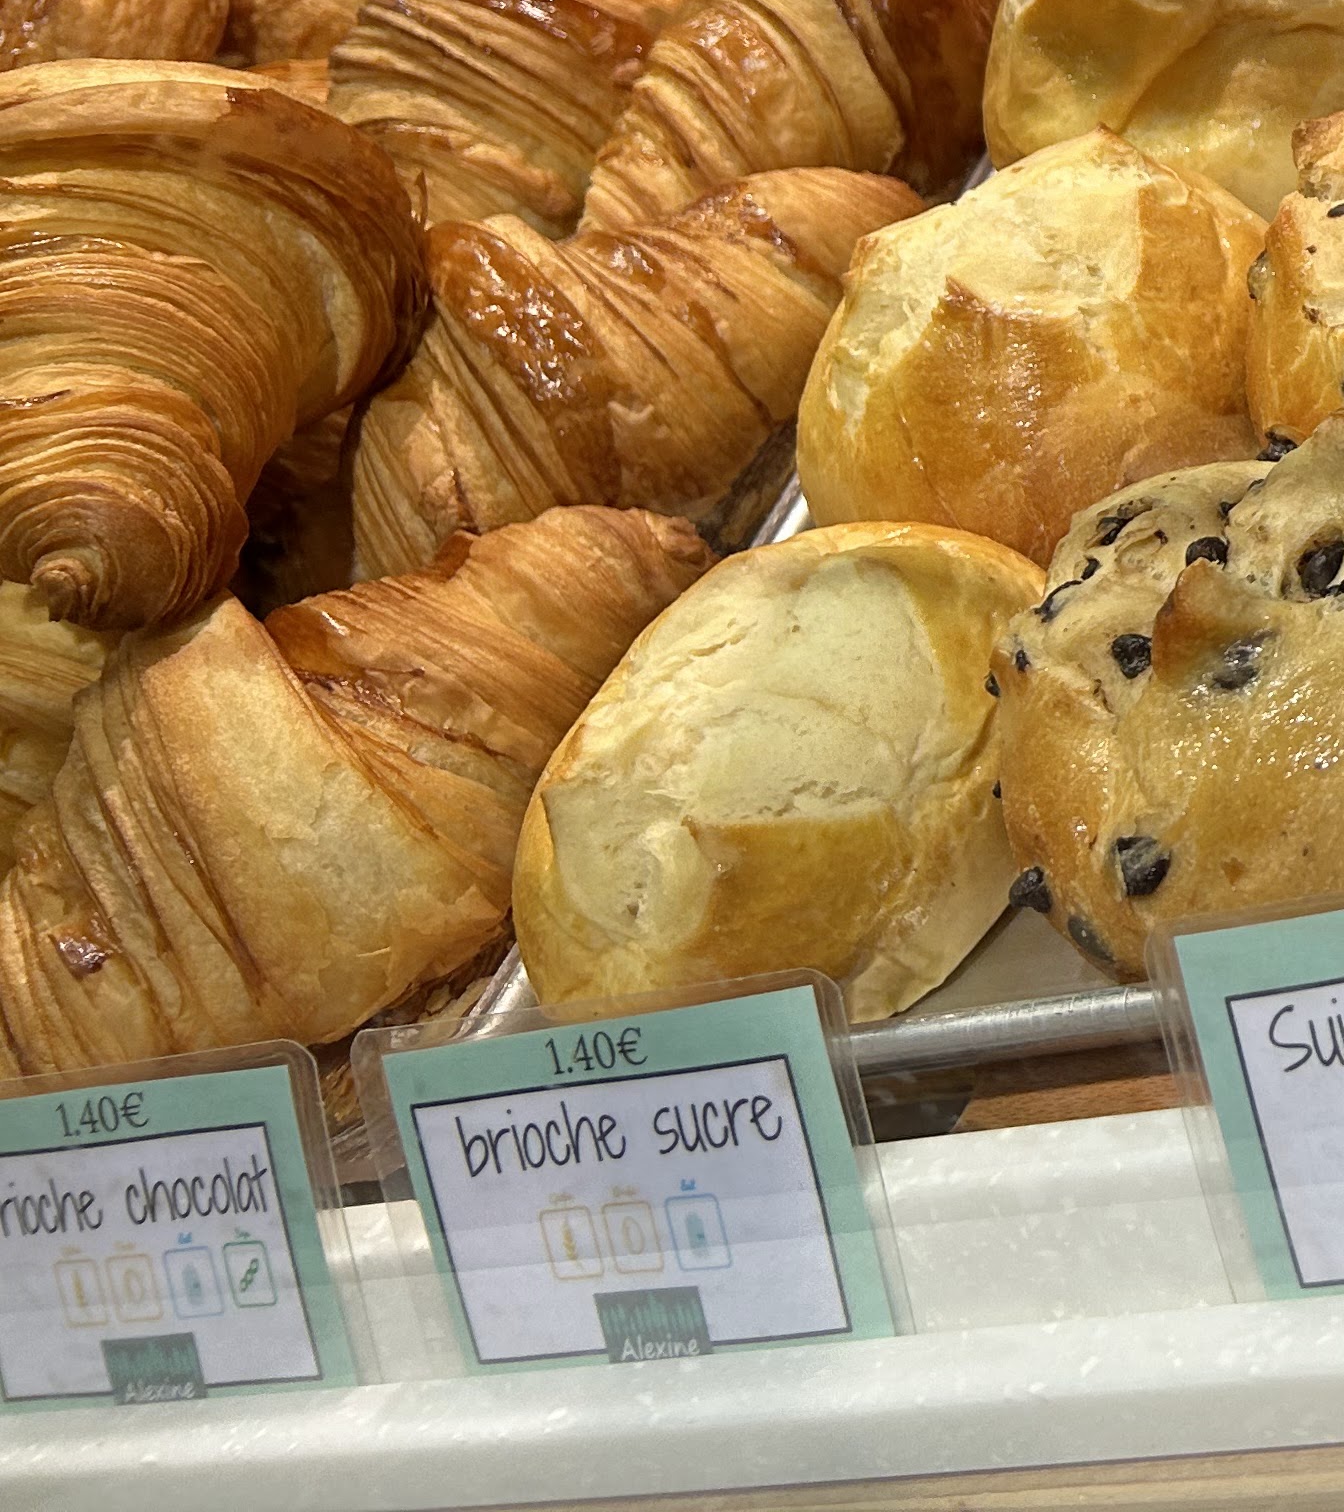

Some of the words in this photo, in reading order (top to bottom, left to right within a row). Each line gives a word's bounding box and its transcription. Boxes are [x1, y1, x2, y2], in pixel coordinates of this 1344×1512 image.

[544, 1026, 649, 1075] 1.40€
[55, 1091, 150, 1138] 1.40€
[454, 1100, 627, 1178] brioche
[653, 1094, 783, 1155] sucre
[0, 1178, 104, 1237] rioche
[125, 1153, 268, 1226] chocolat
[619, 1335, 701, 1362] Alexine
